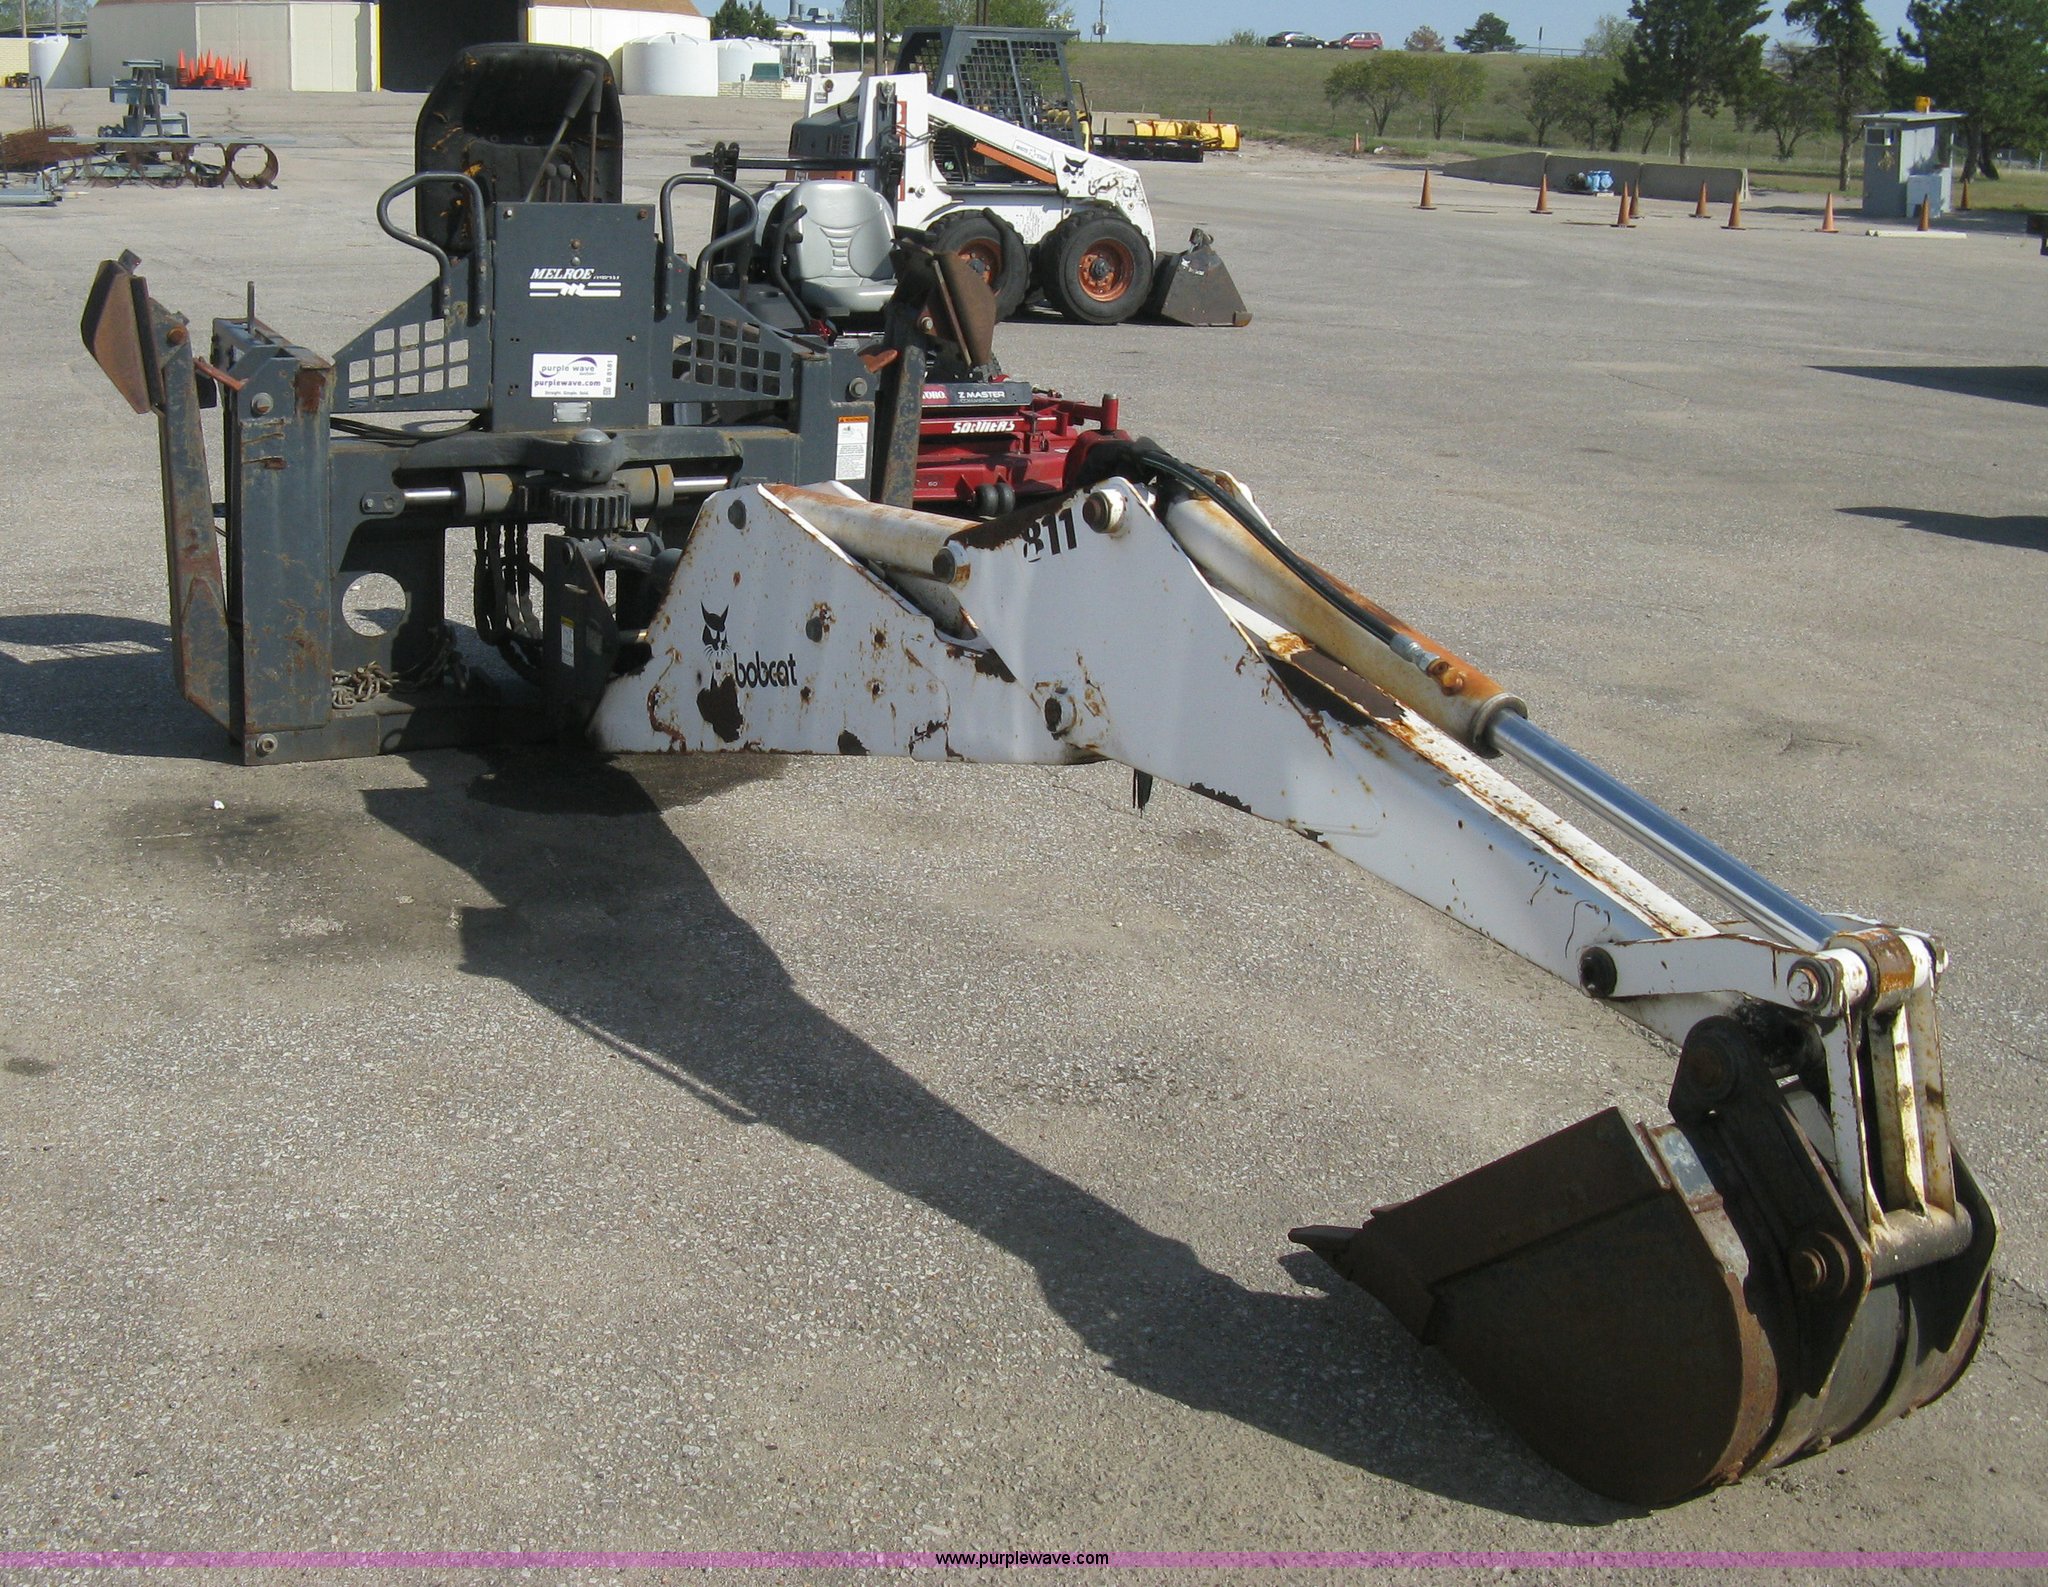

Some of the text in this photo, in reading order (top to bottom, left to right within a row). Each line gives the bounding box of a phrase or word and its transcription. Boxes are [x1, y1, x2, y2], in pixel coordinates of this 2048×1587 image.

[530, 268, 595, 280] MELROE
[541, 364, 595, 374] purple wave
[534, 379, 601, 388] purplewave.com
[957, 391, 966, 399] Z
[966, 391, 1006, 399] MASTER
[1021, 507, 1078, 563] 811
[733, 651, 798, 689] bobcat
